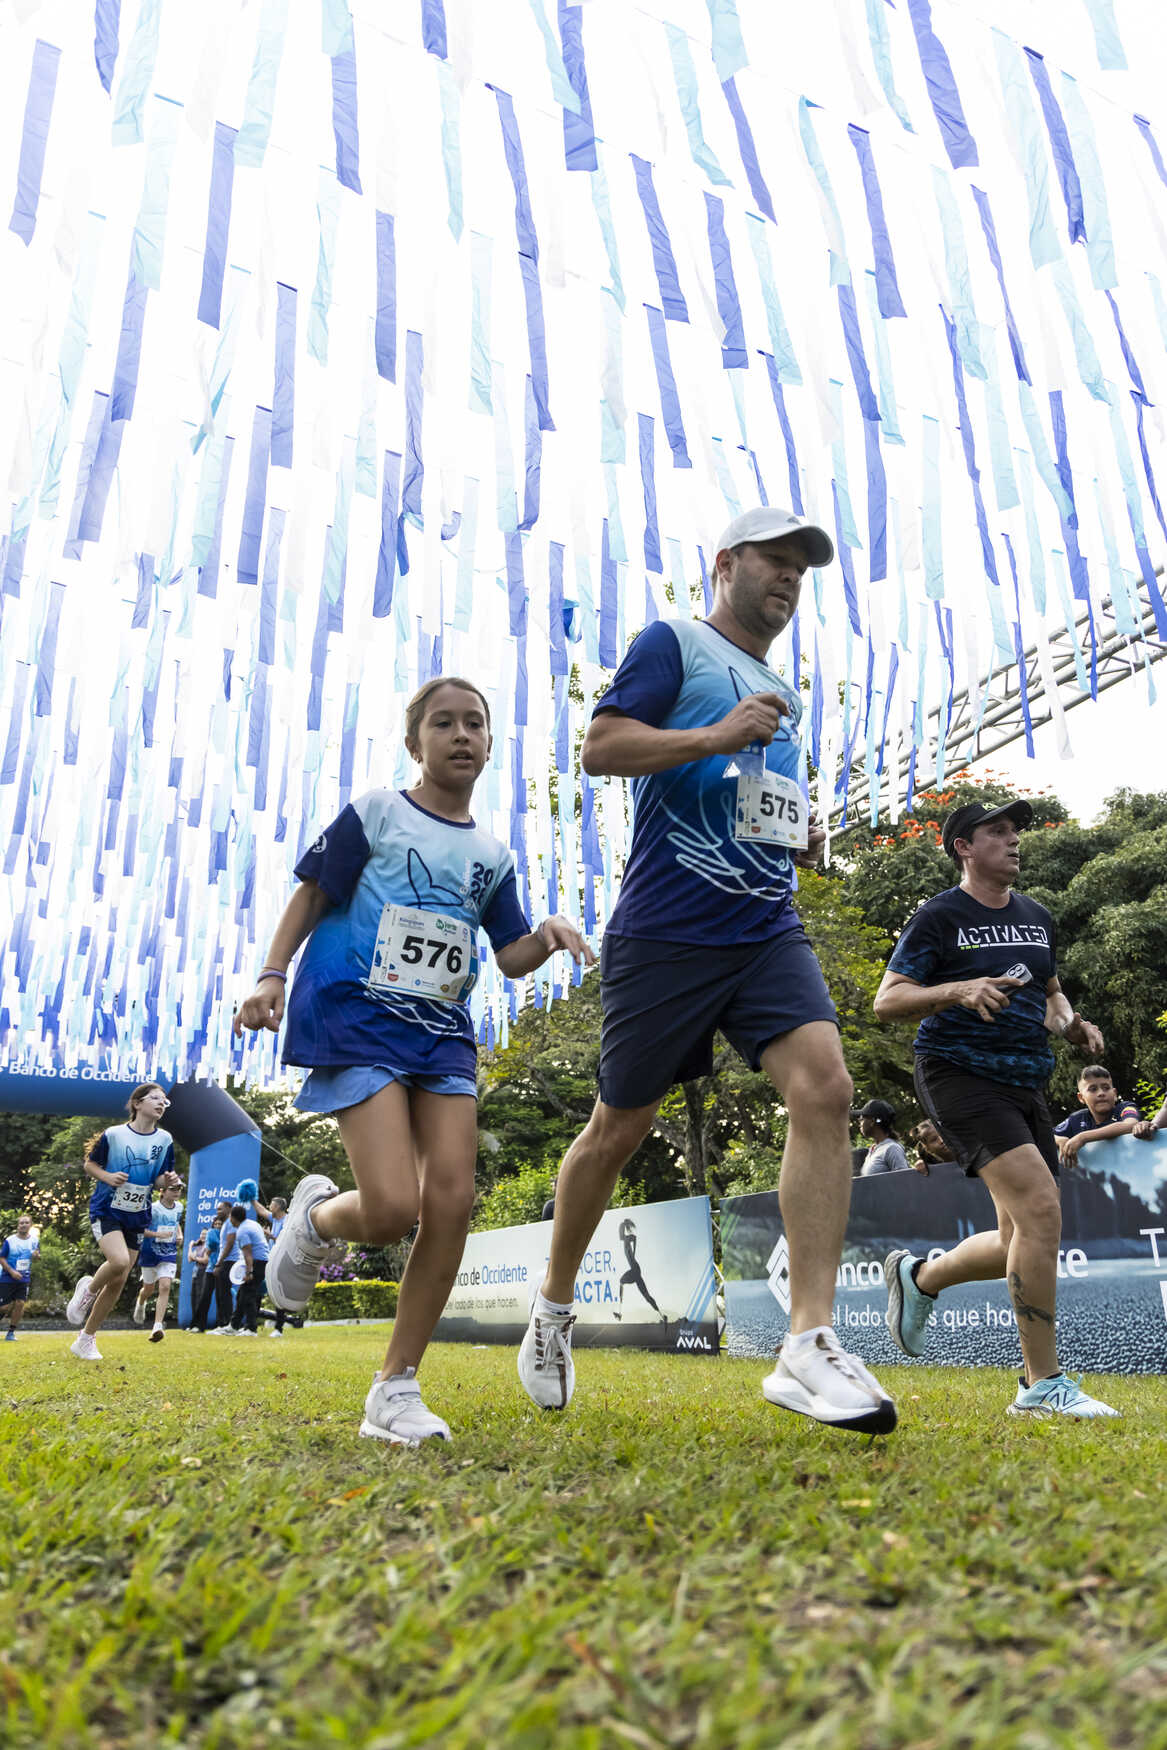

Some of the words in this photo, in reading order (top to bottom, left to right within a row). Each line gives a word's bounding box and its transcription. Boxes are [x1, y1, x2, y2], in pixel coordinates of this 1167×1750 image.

[760, 791, 799, 824] 575
[471, 861, 494, 887] 20
[957, 925, 1049, 946] ACTIVATED
[400, 935, 463, 974] 576
[9, 1061, 57, 1077] Banco
[59, 1065, 79, 1079] de
[81, 1067, 153, 1083] Occidente
[123, 1191, 145, 1203] 326
[199, 1187, 217, 1199] Del
[219, 1187, 238, 1198] lad
[198, 1200, 211, 1211] de
[197, 1213, 217, 1224] hac
[579, 1250, 616, 1274] CER.
[454, 1271, 469, 1286] nco
[470, 1267, 480, 1286] de
[482, 1264, 528, 1285] Occidente
[835, 1261, 884, 1287] nco
[574, 1280, 618, 1303] ACTA.
[831, 1304, 840, 1326] el
[845, 1304, 881, 1327] lado
[943, 1309, 980, 1332] que
[676, 1336, 712, 1350] AVAL
